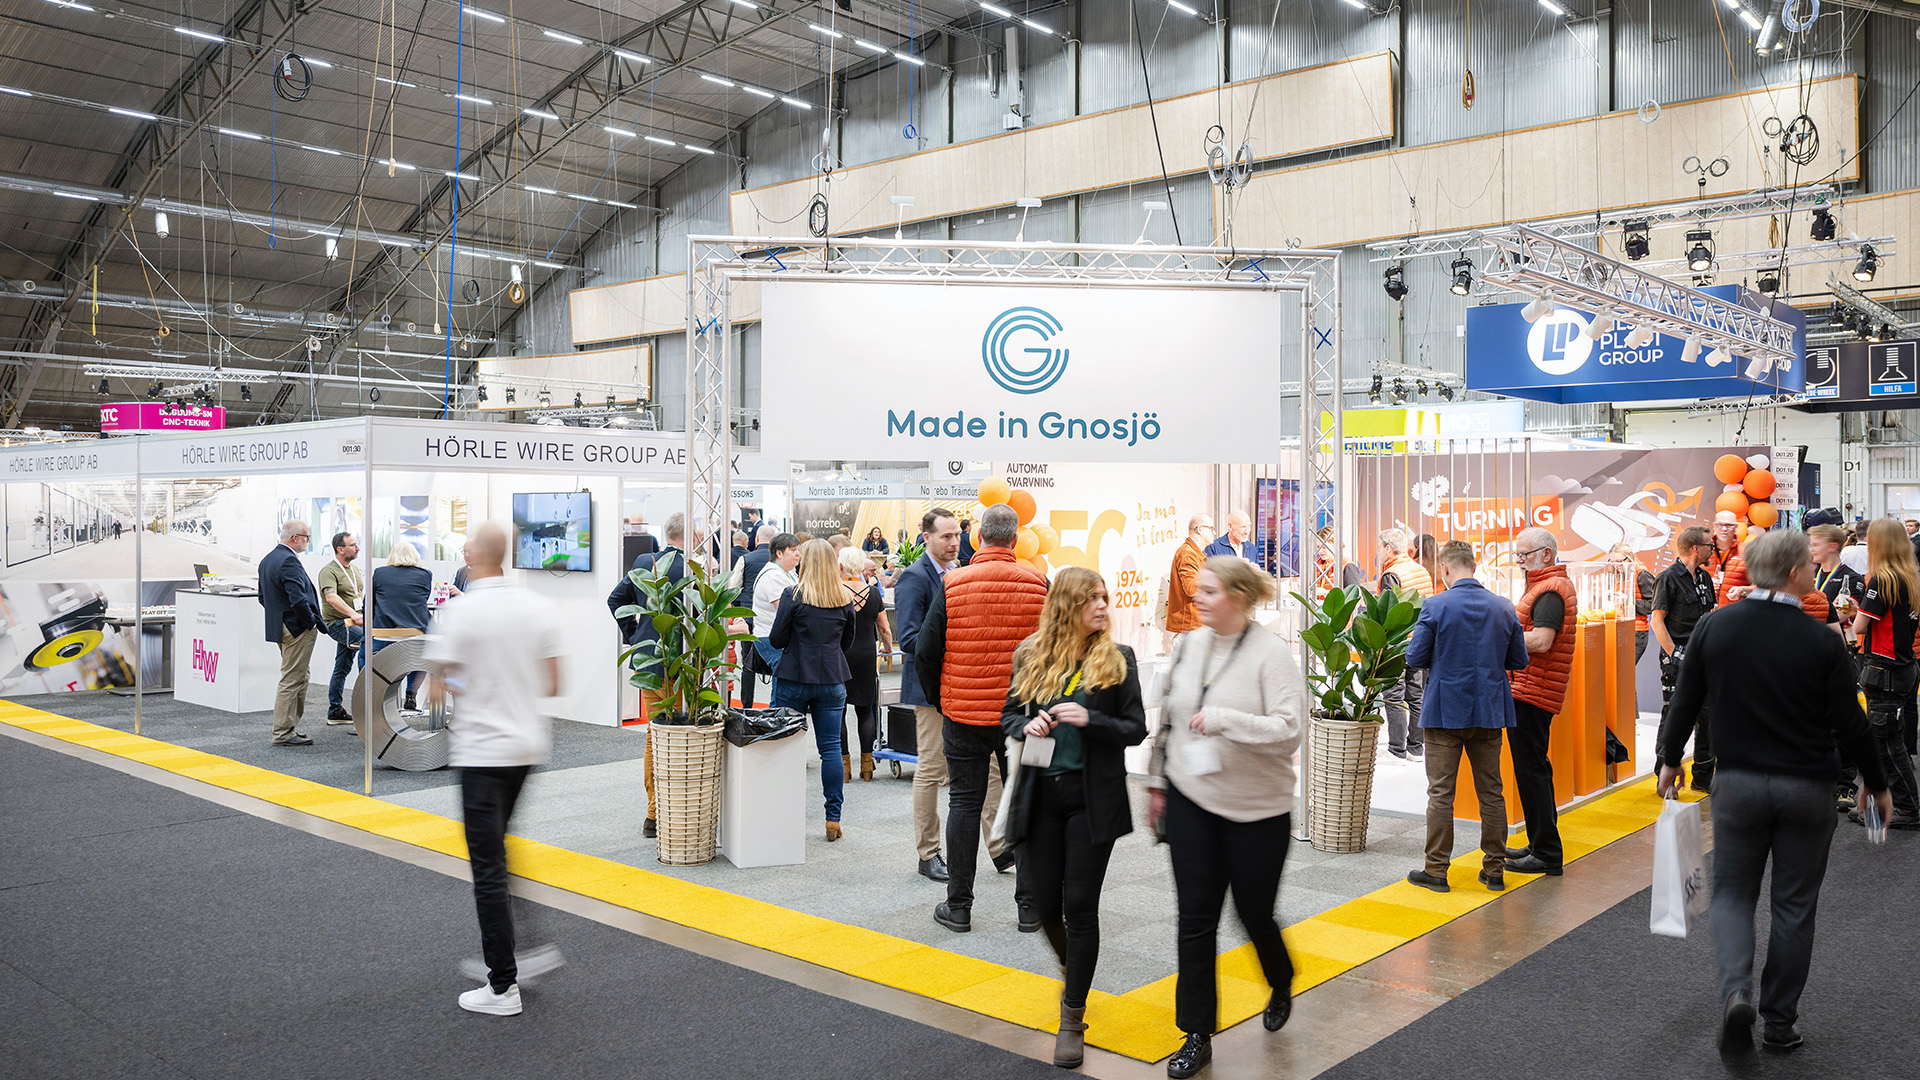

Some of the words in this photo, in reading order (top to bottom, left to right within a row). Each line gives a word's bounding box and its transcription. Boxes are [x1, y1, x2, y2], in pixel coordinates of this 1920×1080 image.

[1600, 331, 1660, 350] PLT
[1599, 348, 1664, 365] GROUP
[1884, 385, 1903, 393] HILFA
[163, 418, 211, 427] CNC-TEKNIK
[887, 408, 987, 438] Made
[999, 410, 1028, 439] in
[1038, 411, 1162, 448] Gnosjö
[182, 445, 215, 464] HÖRLE
[218, 444, 246, 463] WIRE
[250, 442, 290, 462] GROUP
[293, 441, 308, 460] AB
[425, 435, 508, 460] HÖRLE
[517, 441, 575, 462] WIRE
[583, 444, 658, 465] GROUP
[663, 448, 687, 466] AB
[9, 457, 34, 473] HÖRLE
[35, 456, 55, 471] WIRE
[57, 455, 86, 471] GROUP
[87, 454, 98, 469] AB
[1006, 462, 1048, 475] AUTOMAT
[1844, 461, 1861, 472] D1
[808, 486, 836, 496] Norrebo
[838, 485, 875, 496] Träindustri
[877, 484, 889, 495] AB
[920, 485, 949, 496] Norebo
[1006, 476, 1055, 488] SVARVNING
[806, 516, 841, 528] norrebo
[1437, 505, 1555, 533] TURNING
[1115, 570, 1149, 588] 1974-
[1115, 590, 1149, 609] 2024
